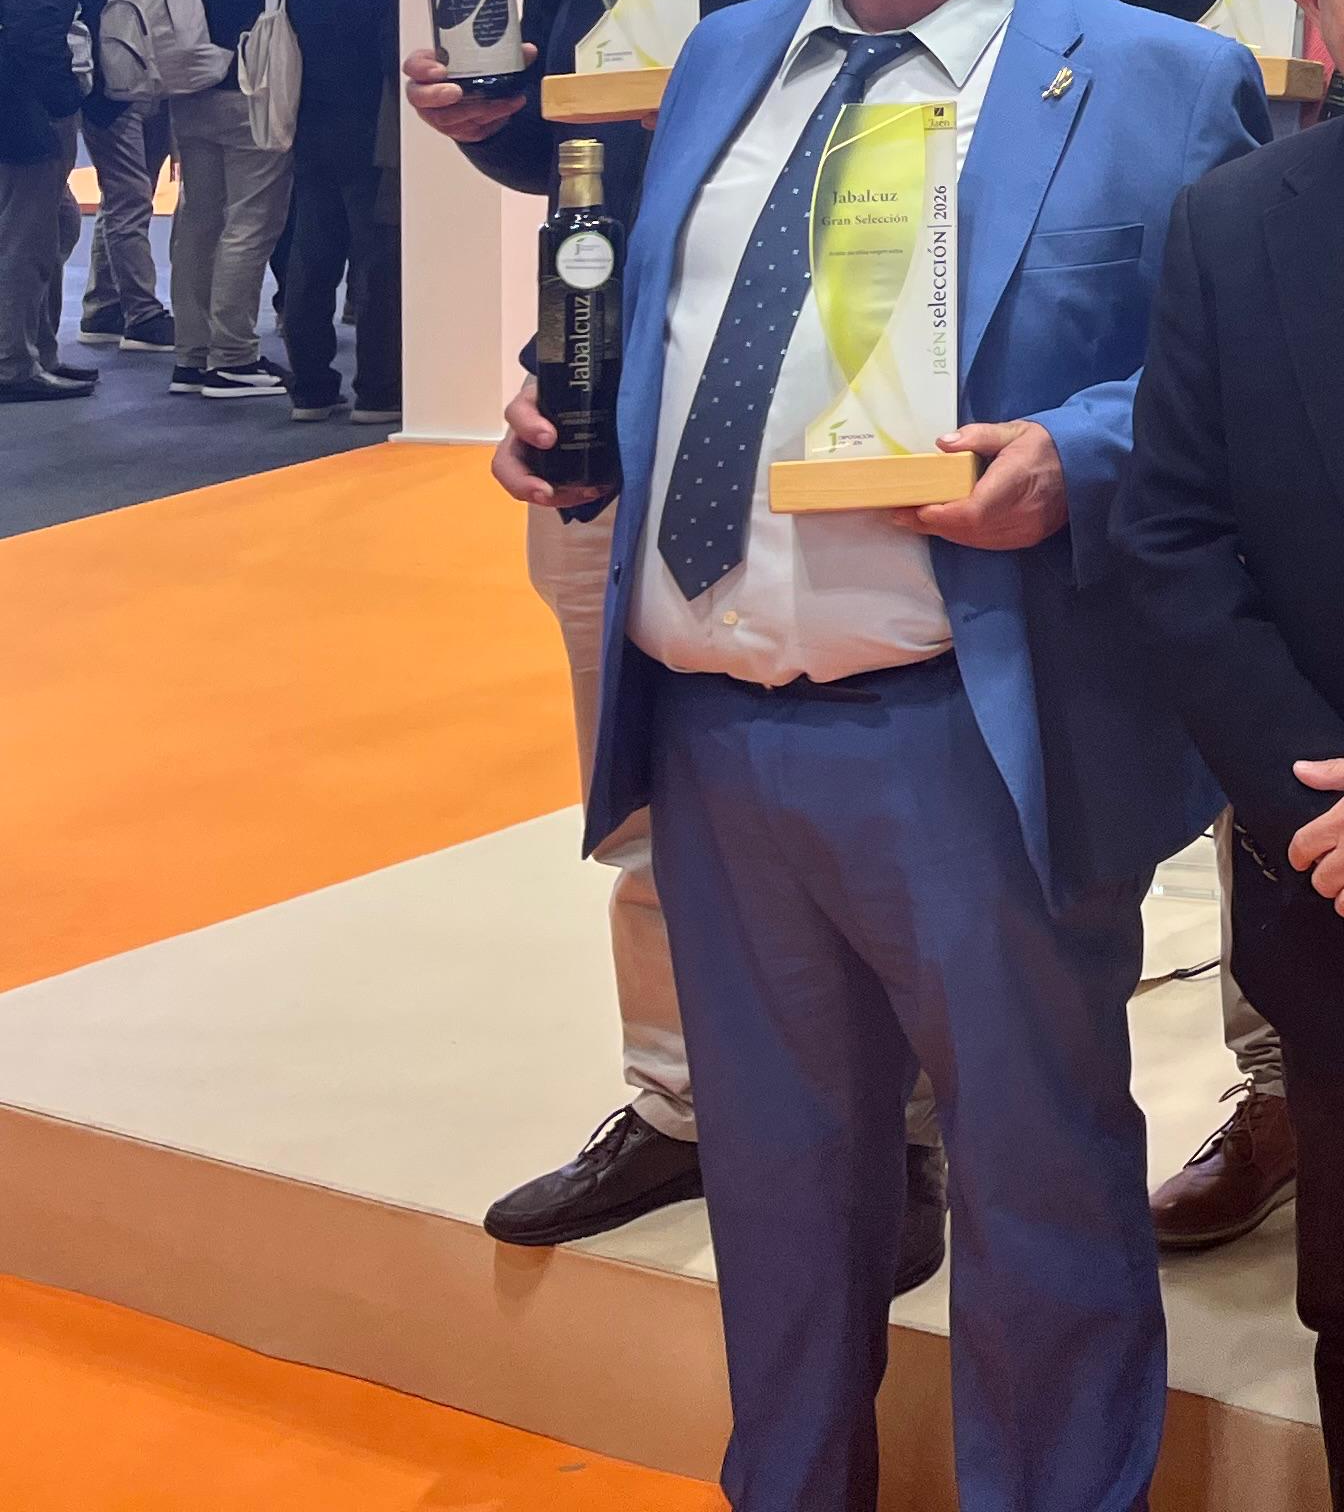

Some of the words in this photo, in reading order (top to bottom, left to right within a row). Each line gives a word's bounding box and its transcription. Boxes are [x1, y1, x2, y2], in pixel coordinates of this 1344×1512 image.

[833, 189, 898, 205] Jabalcuz
[933, 185, 947, 219] 2026
[822, 216, 851, 226] Gran
[855, 213, 908, 225] Selección
[568, 295, 591, 392] Jabalcuz
